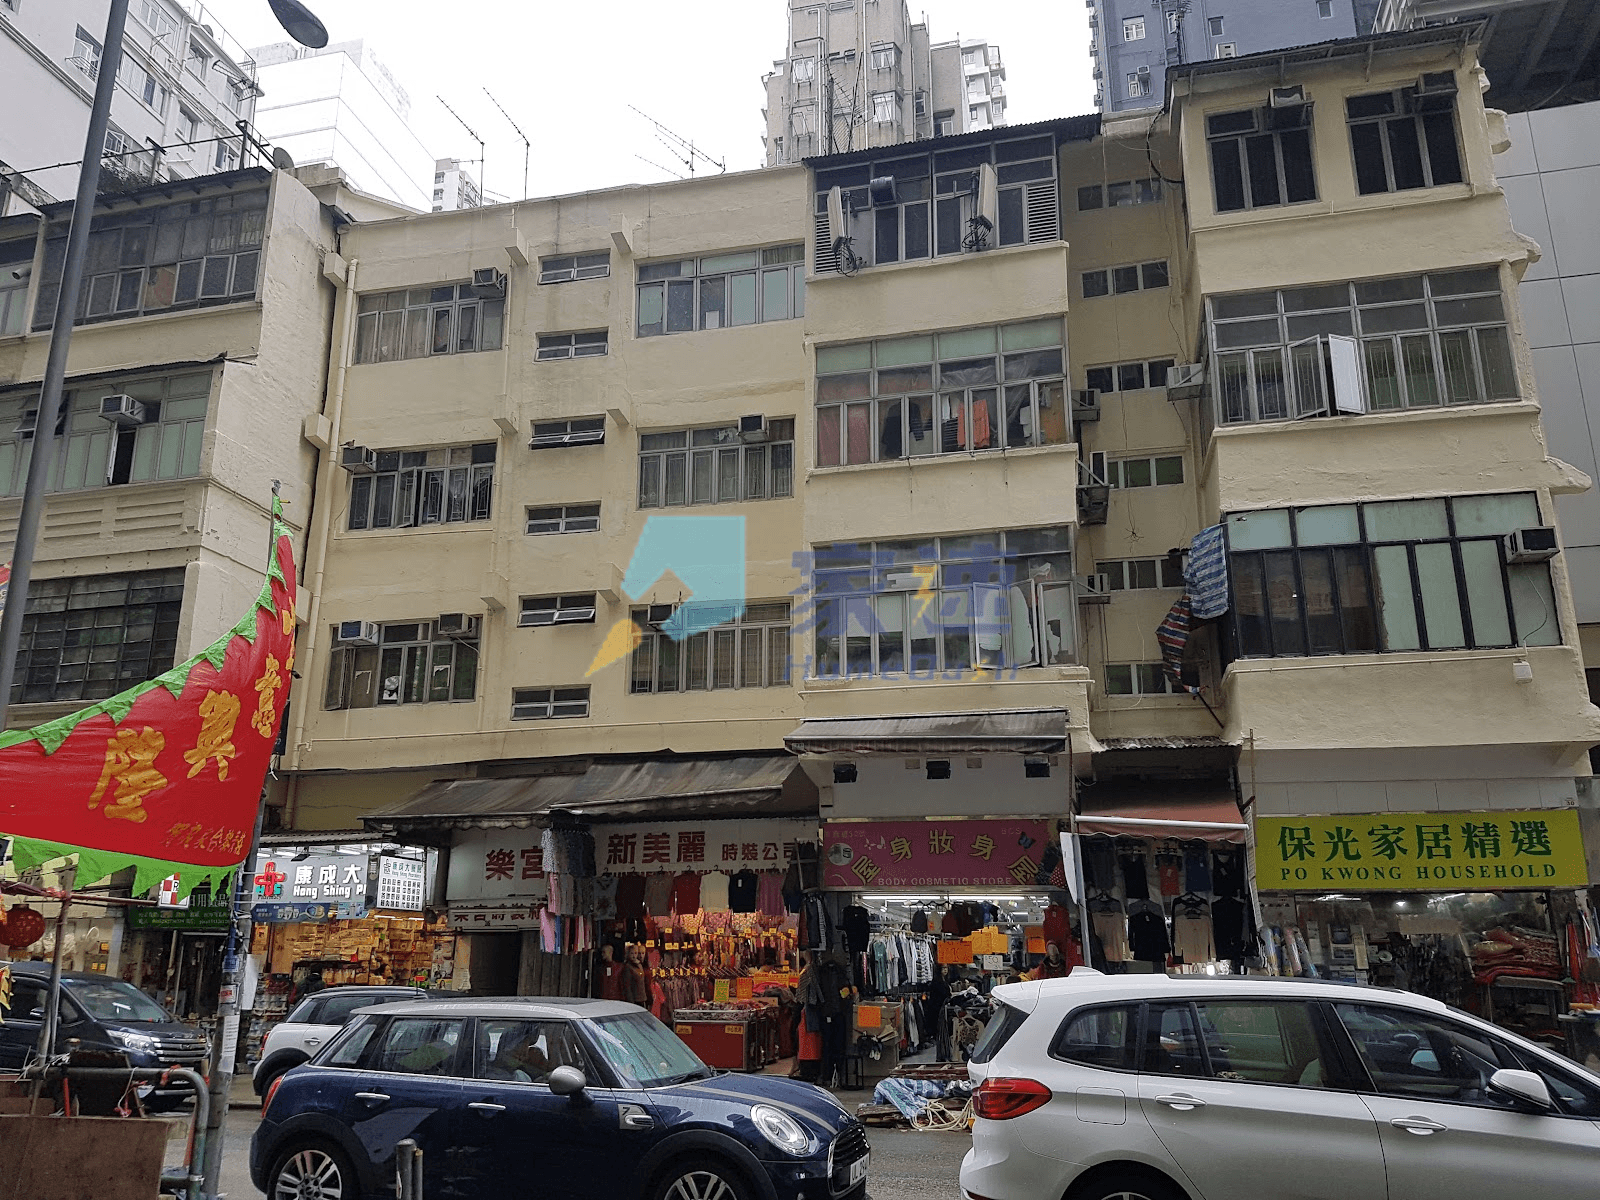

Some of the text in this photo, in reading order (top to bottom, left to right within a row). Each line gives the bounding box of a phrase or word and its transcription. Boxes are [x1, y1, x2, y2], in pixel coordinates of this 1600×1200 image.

[606, 831, 706, 865] 新美麗
[1277, 820, 1553, 862] 保光家居精選
[721, 842, 798, 862] 時裝公司
[877, 877, 1012, 886] BODY COSMETIC STORE
[1281, 863, 1556, 881] PO KWONG HOUSEHOLD
[293, 885, 318, 899] Hong
[323, 884, 351, 898] Shing
